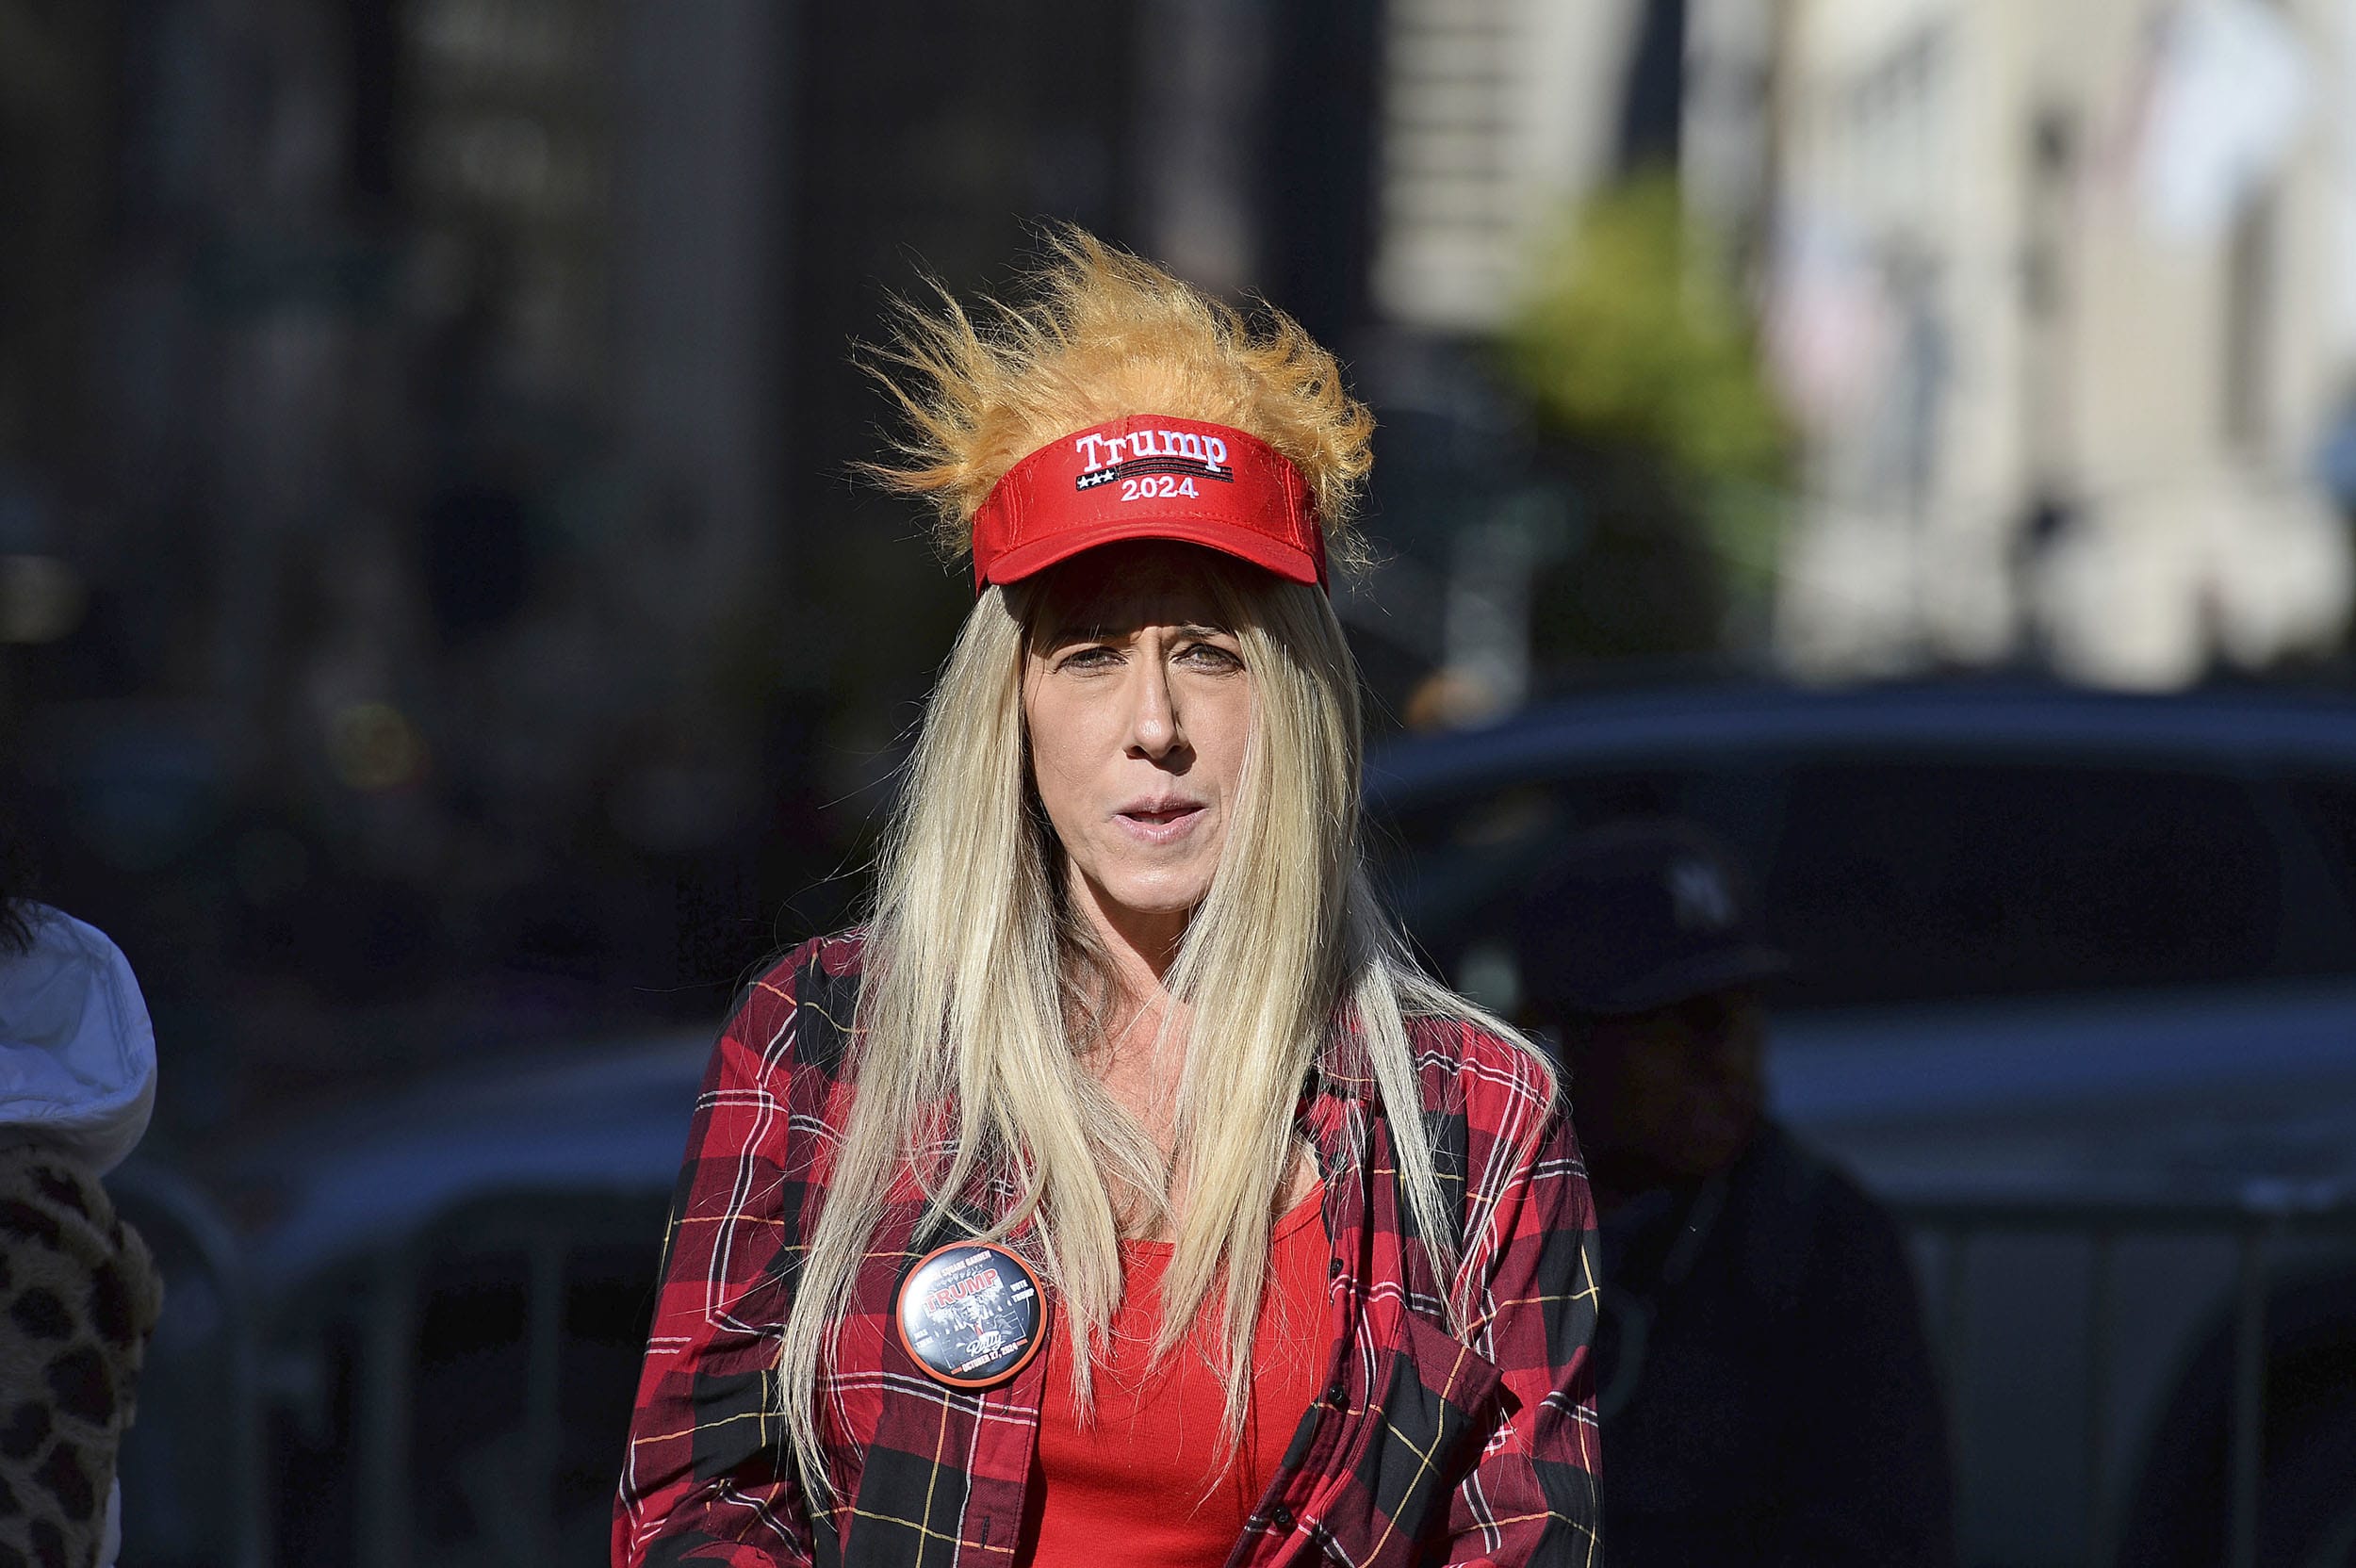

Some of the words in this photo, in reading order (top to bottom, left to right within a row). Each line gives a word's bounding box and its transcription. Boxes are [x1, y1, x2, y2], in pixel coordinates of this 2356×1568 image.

[1076, 430, 1228, 472] Trump
[1121, 476, 1199, 502] 2024
[924, 1268, 998, 1312] TRUMP
[1000, 1343, 1019, 1356] 2024
